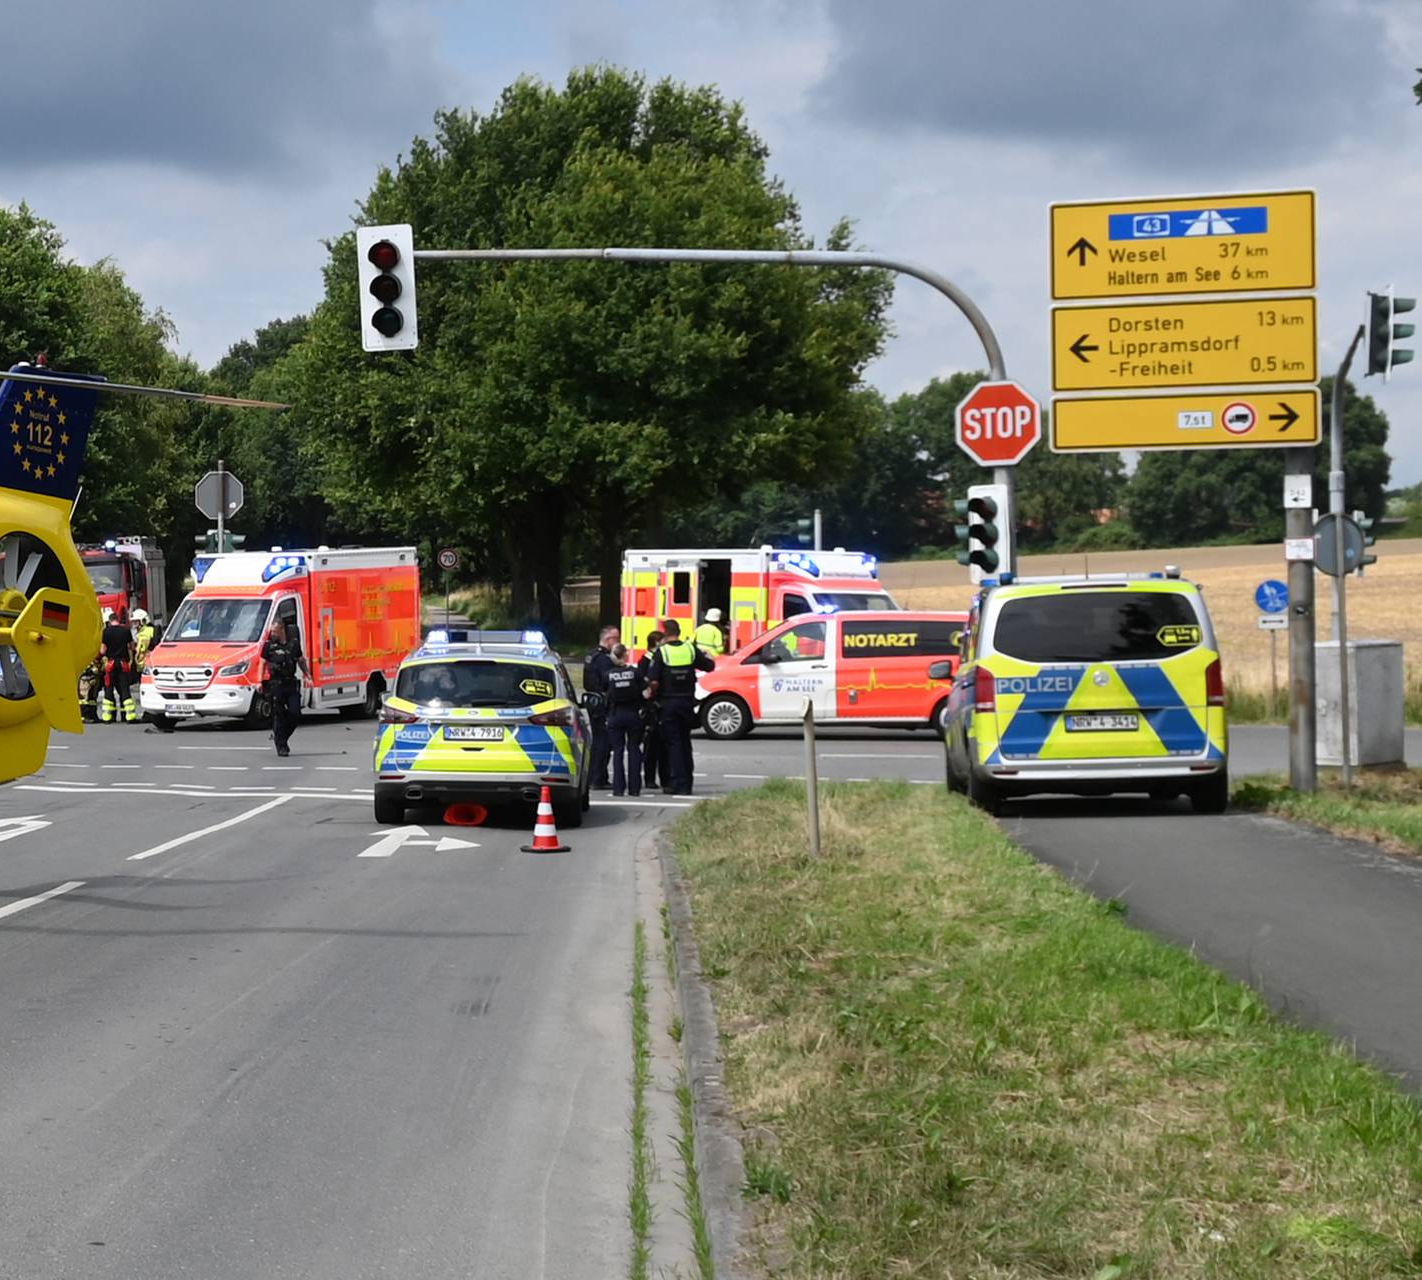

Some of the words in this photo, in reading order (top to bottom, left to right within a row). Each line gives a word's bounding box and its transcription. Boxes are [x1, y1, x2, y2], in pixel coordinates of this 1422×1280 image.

[1142, 219, 1162, 232] 43
[1108, 246, 1167, 263] Wesel
[1218, 242, 1241, 258] 37
[1246, 245, 1269, 257] km
[1108, 270, 1159, 286] Haltern
[1166, 270, 1188, 284] am
[1195, 266, 1221, 282] See
[1231, 265, 1241, 280] 6
[1246, 268, 1269, 280] km
[1108, 317, 1184, 333] Dorsten
[1258, 311, 1276, 326] 13
[1281, 313, 1304, 326] km
[1108, 335, 1240, 358] Lippramsdorf
[1109, 360, 1194, 377] -Freiheit
[1282, 360, 1305, 372] km
[964, 405, 1032, 440] STOP
[26, 421, 53, 446] 112
[843, 632, 919, 648] NOTARZT
[998, 677, 1073, 693] POLIZEI
